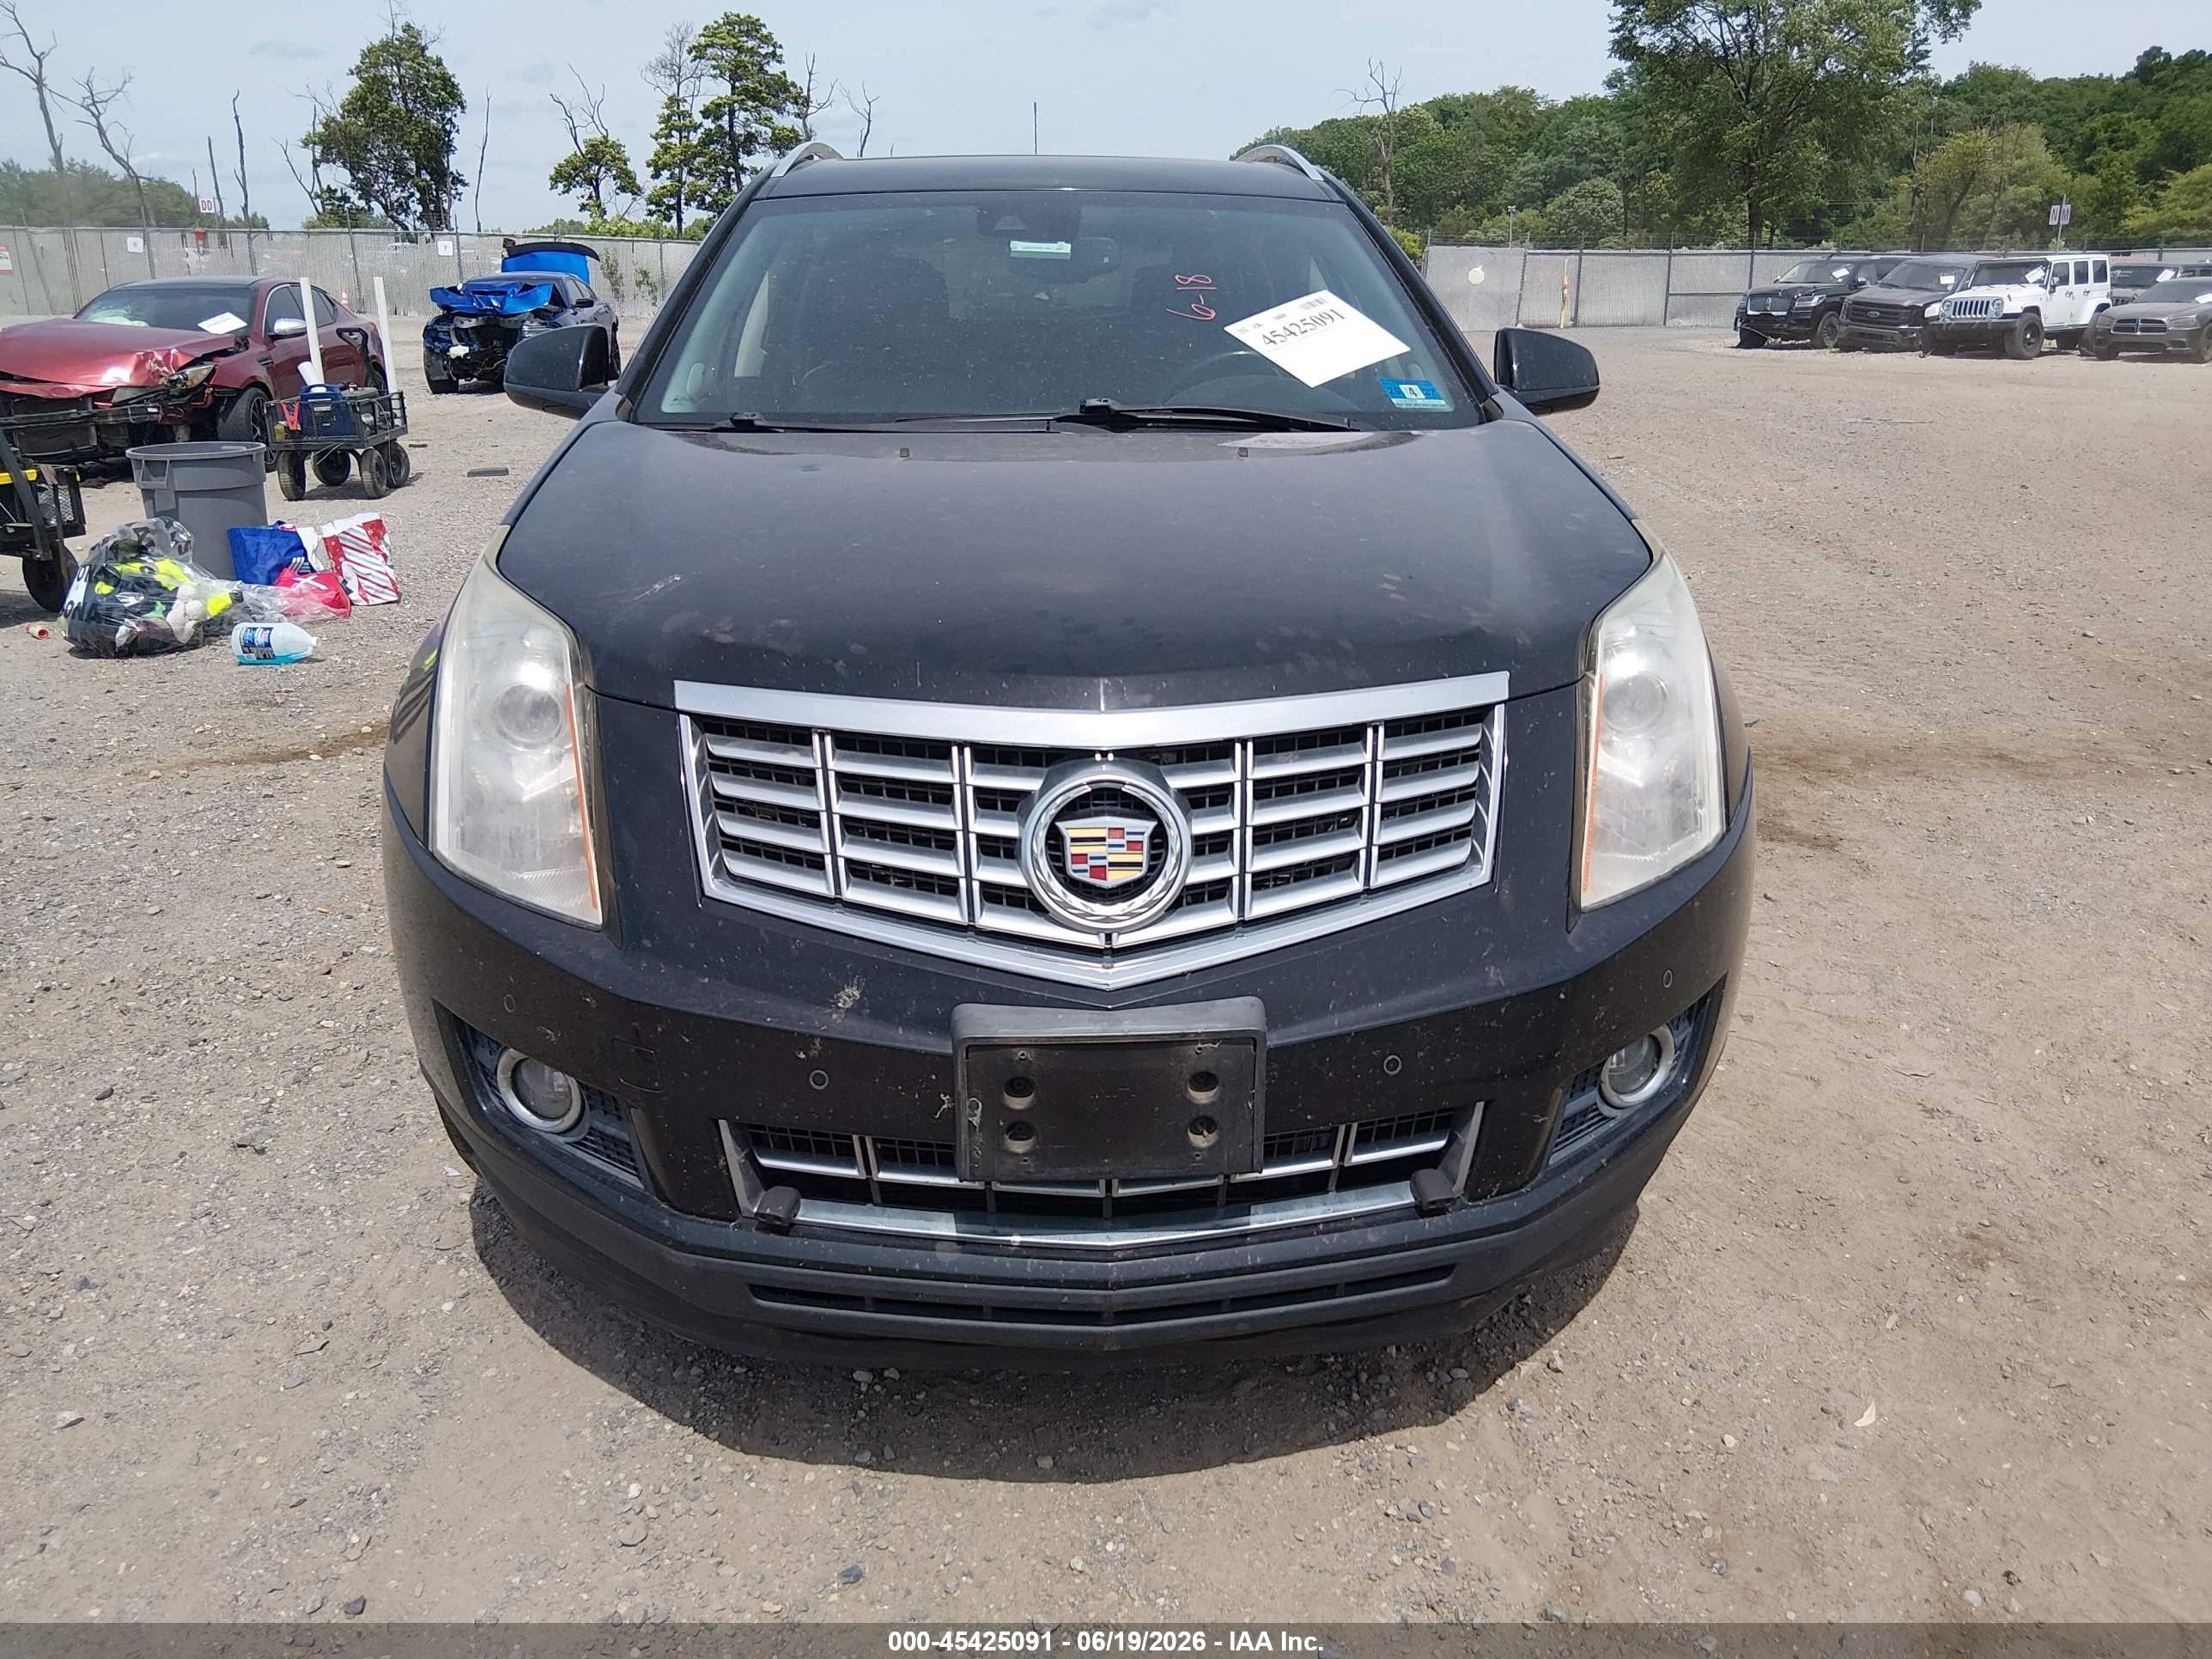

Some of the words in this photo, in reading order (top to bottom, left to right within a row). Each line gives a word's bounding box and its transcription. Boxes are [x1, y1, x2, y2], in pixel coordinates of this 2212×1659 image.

[201, 200, 212, 210] DD
[2051, 209, 2058, 221] N
[2061, 209, 2069, 221] M
[1166, 274, 1218, 320] 6-18
[1261, 308, 1346, 346] 45425091
[1408, 386, 1418, 398] 4
